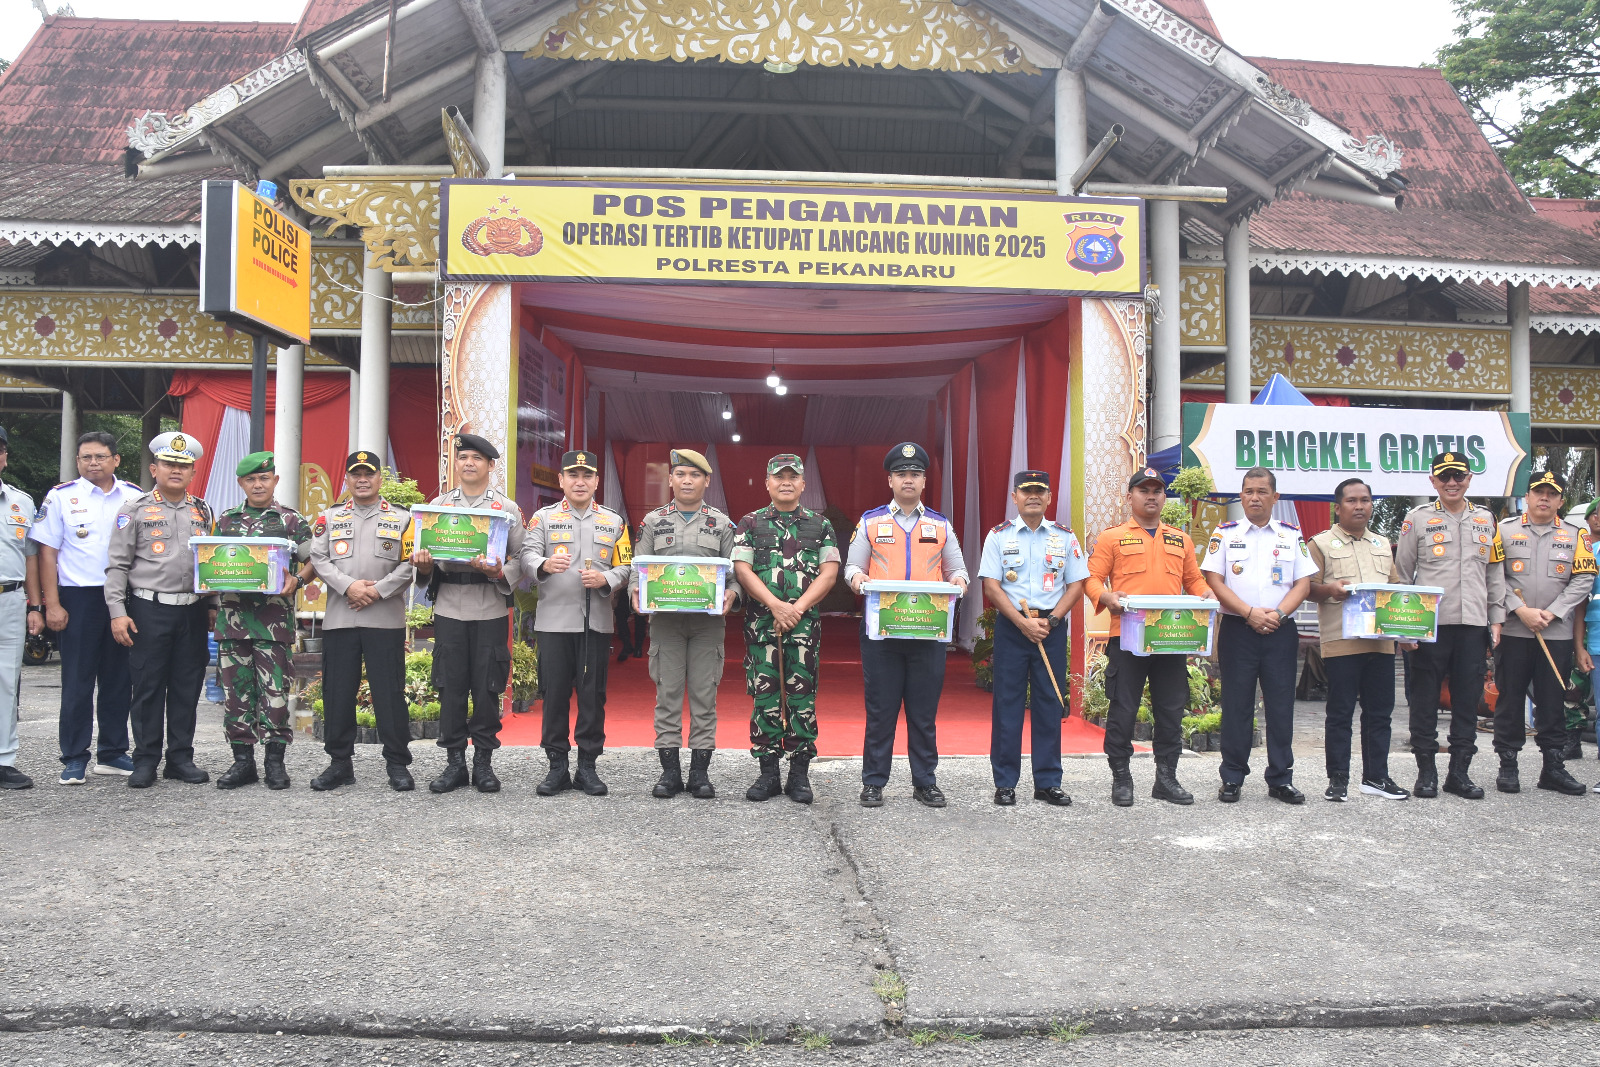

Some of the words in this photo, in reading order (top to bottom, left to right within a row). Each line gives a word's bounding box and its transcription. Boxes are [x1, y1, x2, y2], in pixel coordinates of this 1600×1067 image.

[593, 194, 686, 218] POS
[700, 197, 1018, 228] PENGAMANAN
[1071, 214, 1116, 223] RIAU
[254, 200, 298, 248] POLISI
[562, 222, 648, 246] OPERASI
[653, 224, 722, 248] TERTIB
[728, 226, 813, 250] KETUPAT
[818, 229, 910, 254] LANCANG
[914, 232, 990, 256] KUNING
[994, 234, 1046, 258] 2025
[252, 227, 298, 274] POLICE
[656, 258, 790, 274] POLRESTA
[798, 262, 956, 278] PEKANBARU
[1235, 430, 1372, 472] BENGKEL
[1379, 432, 1487, 474] GRATIS
[332, 522, 352, 530] JOSSY
[377, 522, 400, 530] POLRI
[595, 525, 615, 534] POLRI
[1472, 526, 1490, 534] POLRI
[1573, 559, 1581, 570] KA
